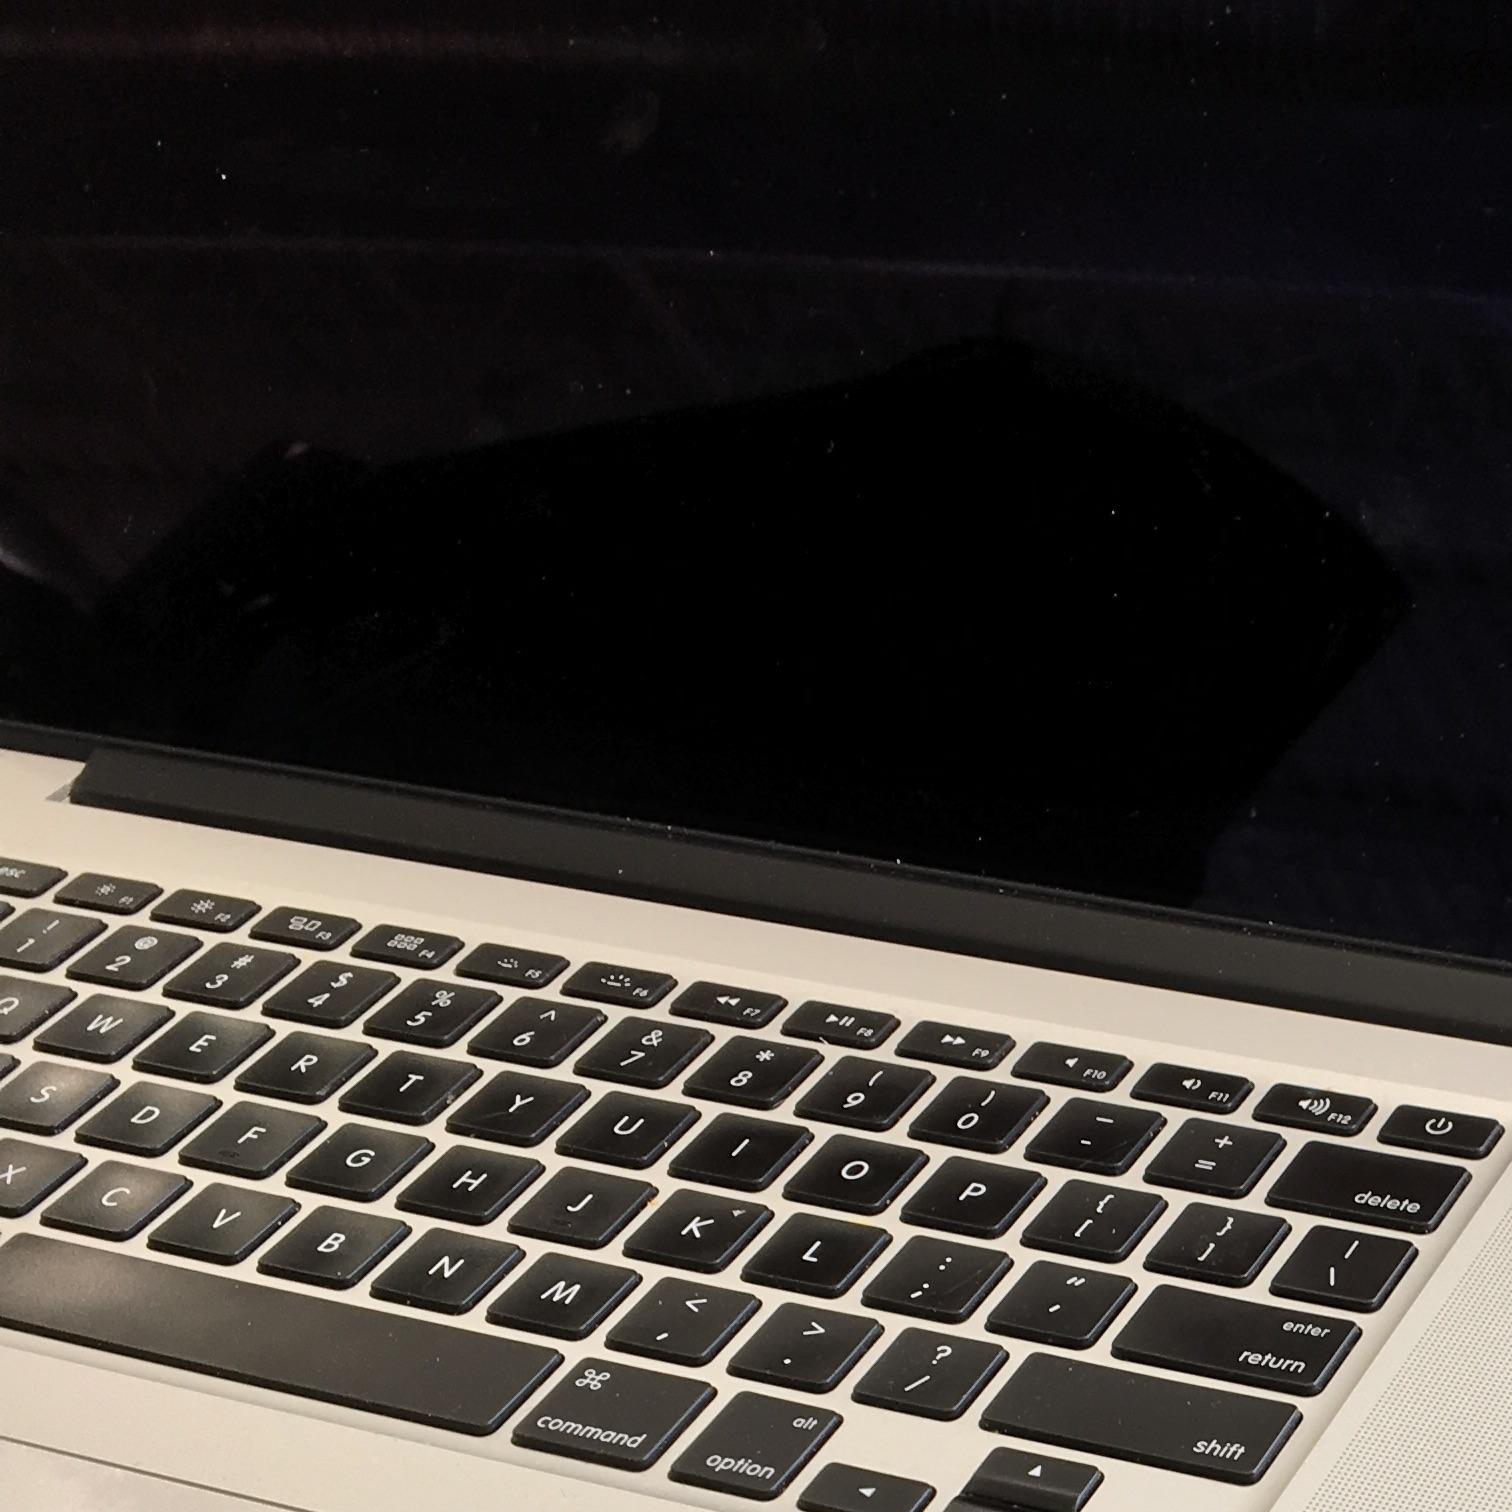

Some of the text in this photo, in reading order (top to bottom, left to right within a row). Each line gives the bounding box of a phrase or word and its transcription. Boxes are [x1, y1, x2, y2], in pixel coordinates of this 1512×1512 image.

[315, 931, 332, 941] F3
[105, 955, 132, 972] 2
[418, 949, 436, 959] F4
[205, 973, 229, 989] 3
[524, 969, 543, 979] F5
[307, 992, 331, 1008] 4
[632, 987, 649, 997] F6
[406, 1010, 433, 1027] 5
[742, 1007, 761, 1017] F7
[86, 1014, 124, 1034] W
[856, 1027, 874, 1037] F8
[188, 1034, 217, 1053] E
[512, 1031, 535, 1046] 6
[620, 1050, 646, 1067] 7
[971, 1047, 990, 1058] F9
[290, 1054, 319, 1073] R
[399, 1073, 425, 1092] T
[730, 1070, 753, 1087] 8
[1082, 1068, 1107, 1080] F10
[30, 1084, 57, 1104] S
[508, 1094, 535, 1113] Y
[842, 1092, 866, 1109] 9
[1208, 1090, 1231, 1104] F11
[130, 1105, 161, 1124] D
[956, 1112, 979, 1130] 0
[1328, 1112, 1351, 1125] F12
[613, 1115, 645, 1135] U
[237, 1126, 267, 1144] F
[345, 1149, 376, 1168] G
[0, 1164, 27, 1185] X
[841, 1160, 870, 1180] O
[452, 1170, 488, 1192] H
[101, 1186, 130, 1207] C
[958, 1182, 987, 1201] P
[566, 1193, 594, 1212] J
[1354, 1190, 1421, 1213] delete
[212, 1208, 242, 1229] V
[680, 1216, 715, 1238] K
[316, 1232, 346, 1253] B
[802, 1240, 822, 1262] L
[428, 1255, 465, 1278] N
[540, 1280, 581, 1305] M
[1282, 1319, 1331, 1338] enter
[1238, 1350, 1306, 1374] return
[536, 1415, 648, 1448] command
[792, 1417, 818, 1430] alt
[1192, 1439, 1245, 1461] shift
[706, 1454, 775, 1480] option
